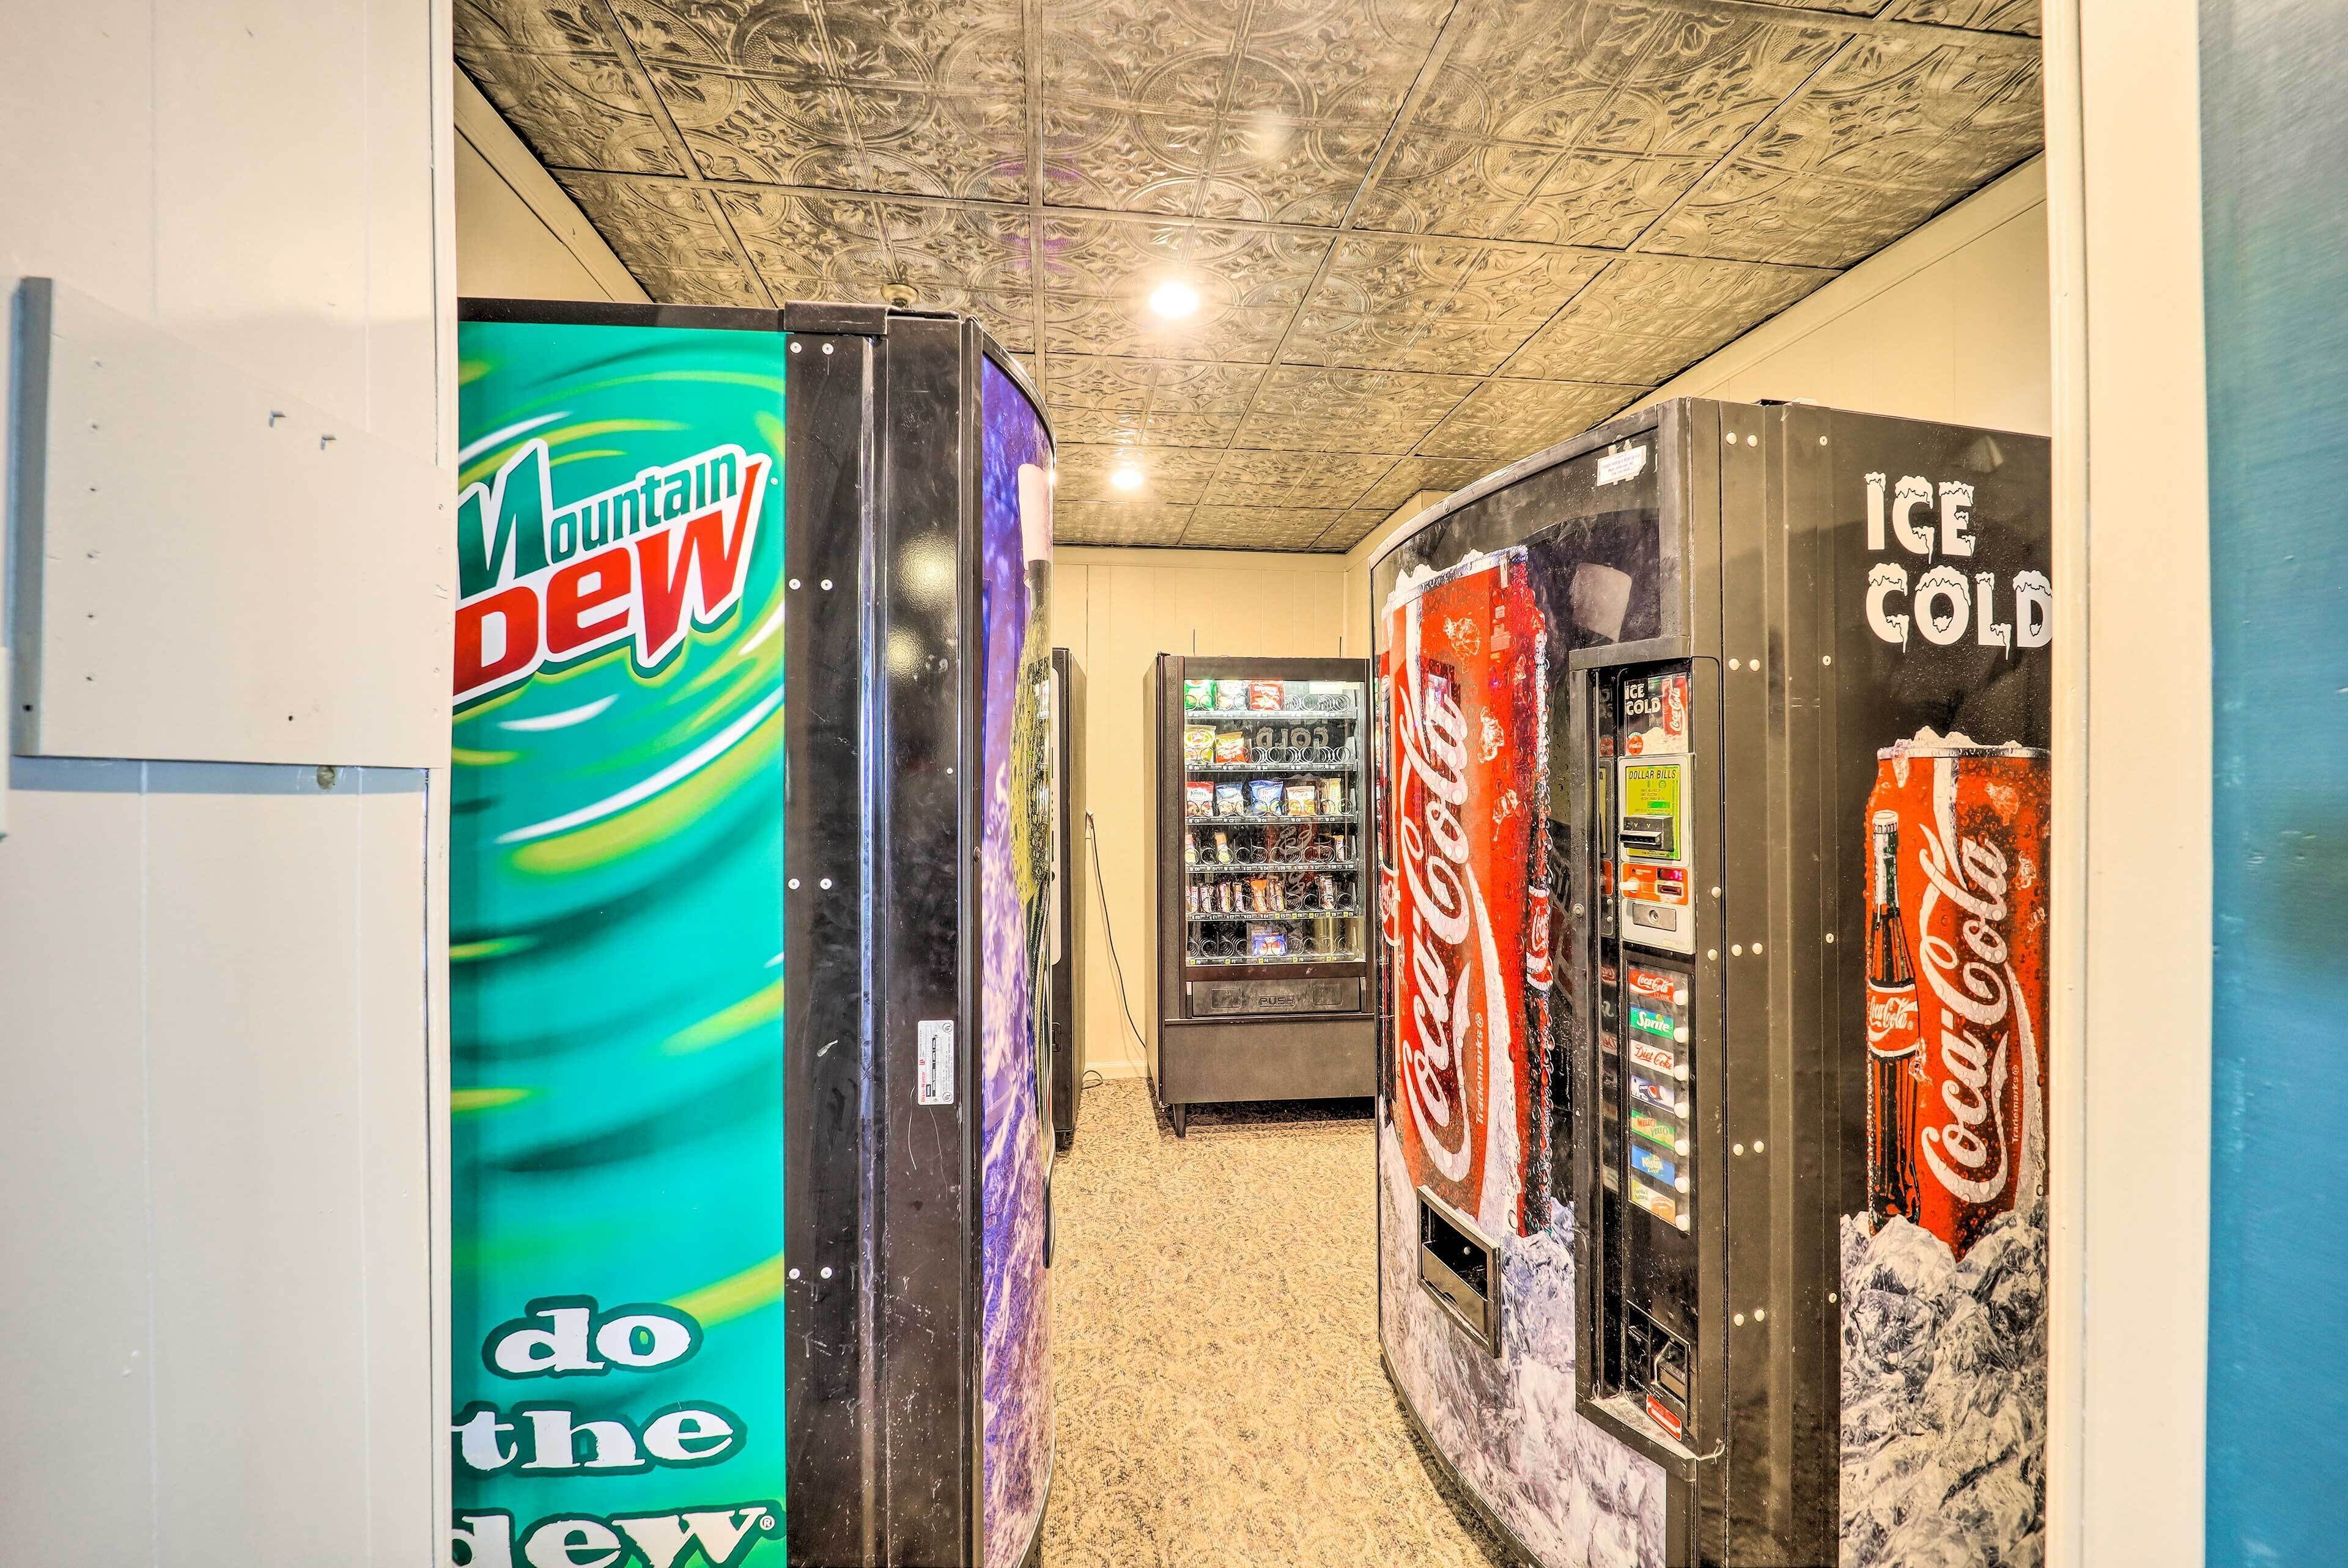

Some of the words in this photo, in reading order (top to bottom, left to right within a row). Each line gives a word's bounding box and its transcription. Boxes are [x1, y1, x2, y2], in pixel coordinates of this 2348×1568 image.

[457, 446, 737, 599] Mountain
[1864, 471, 1976, 564] ICE
[1866, 562, 2053, 660] COLD
[1625, 683, 1645, 700] ICE
[1626, 697, 1661, 716] COLD
[1629, 770, 1654, 779] DOLLAR
[1657, 769, 1677, 779] BILLS
[1399, 686, 1470, 1182] Coca-Cola
[1637, 973, 1669, 993] Coca-Cola
[1919, 823, 2010, 1204] Coca-Cola
[1637, 1011, 1670, 1033] Sprite
[1634, 1044, 1654, 1062] Diet
[1653, 1052, 1673, 1070] Coke
[495, 1308, 692, 1373] do
[451, 1410, 734, 1471] the
